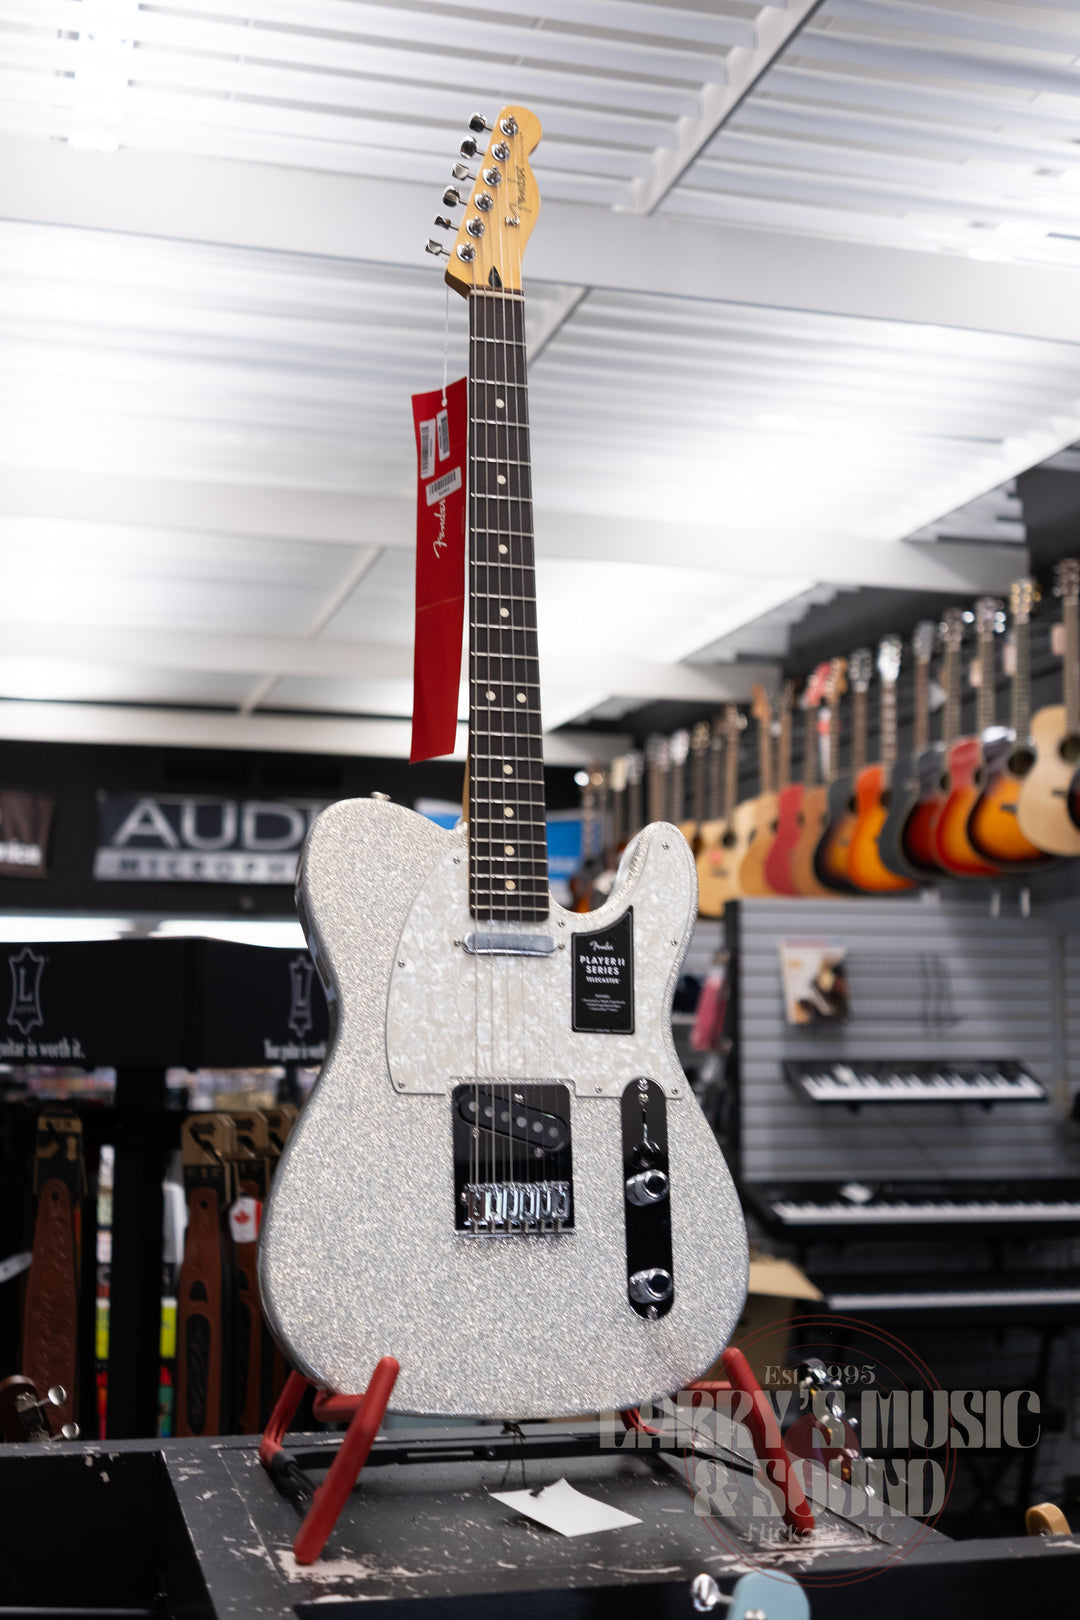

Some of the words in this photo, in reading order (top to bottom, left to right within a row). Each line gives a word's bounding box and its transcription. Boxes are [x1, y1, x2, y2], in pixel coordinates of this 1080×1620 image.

[579, 955, 617, 966] PLAYER
[617, 958, 626, 967] II
[586, 965, 620, 975] SERIES
